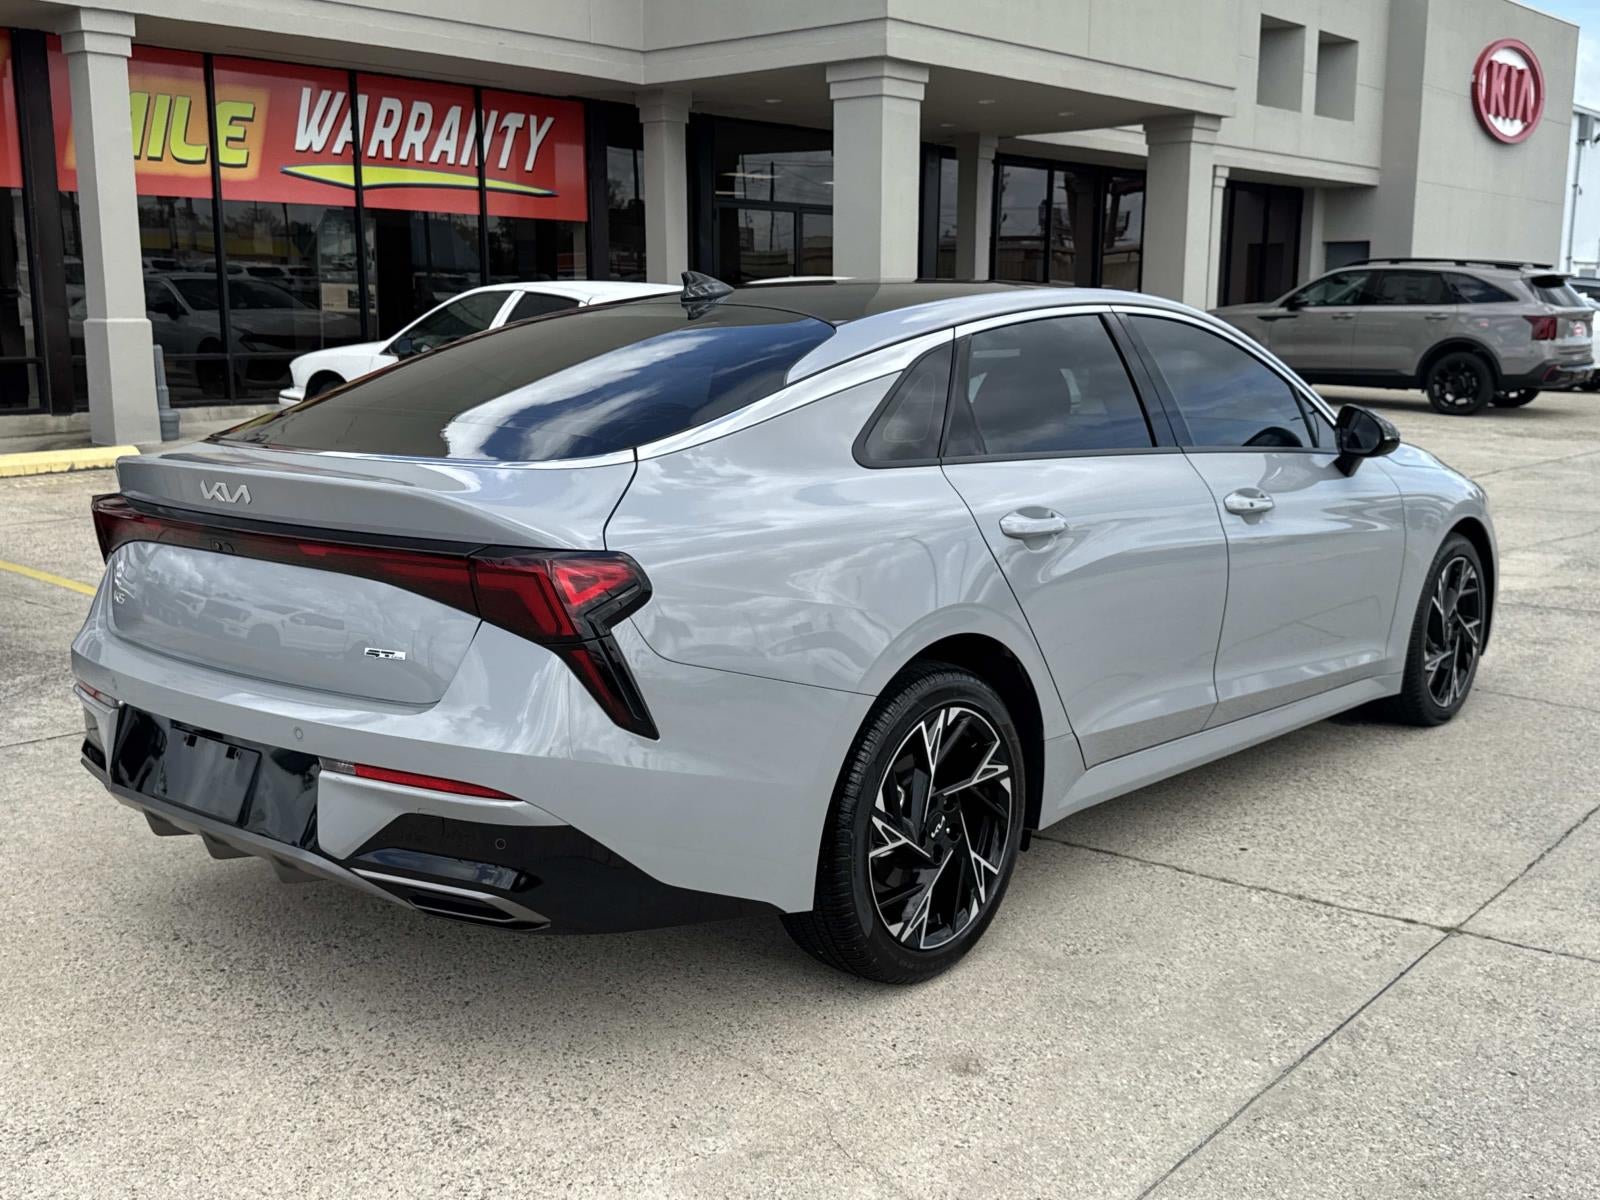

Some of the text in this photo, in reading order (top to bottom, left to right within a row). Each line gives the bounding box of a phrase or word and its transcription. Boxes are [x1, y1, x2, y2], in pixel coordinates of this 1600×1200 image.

[1486, 60, 1534, 123] KIA
[294, 87, 555, 172] WARRANTY
[200, 480, 252, 504] KIA
